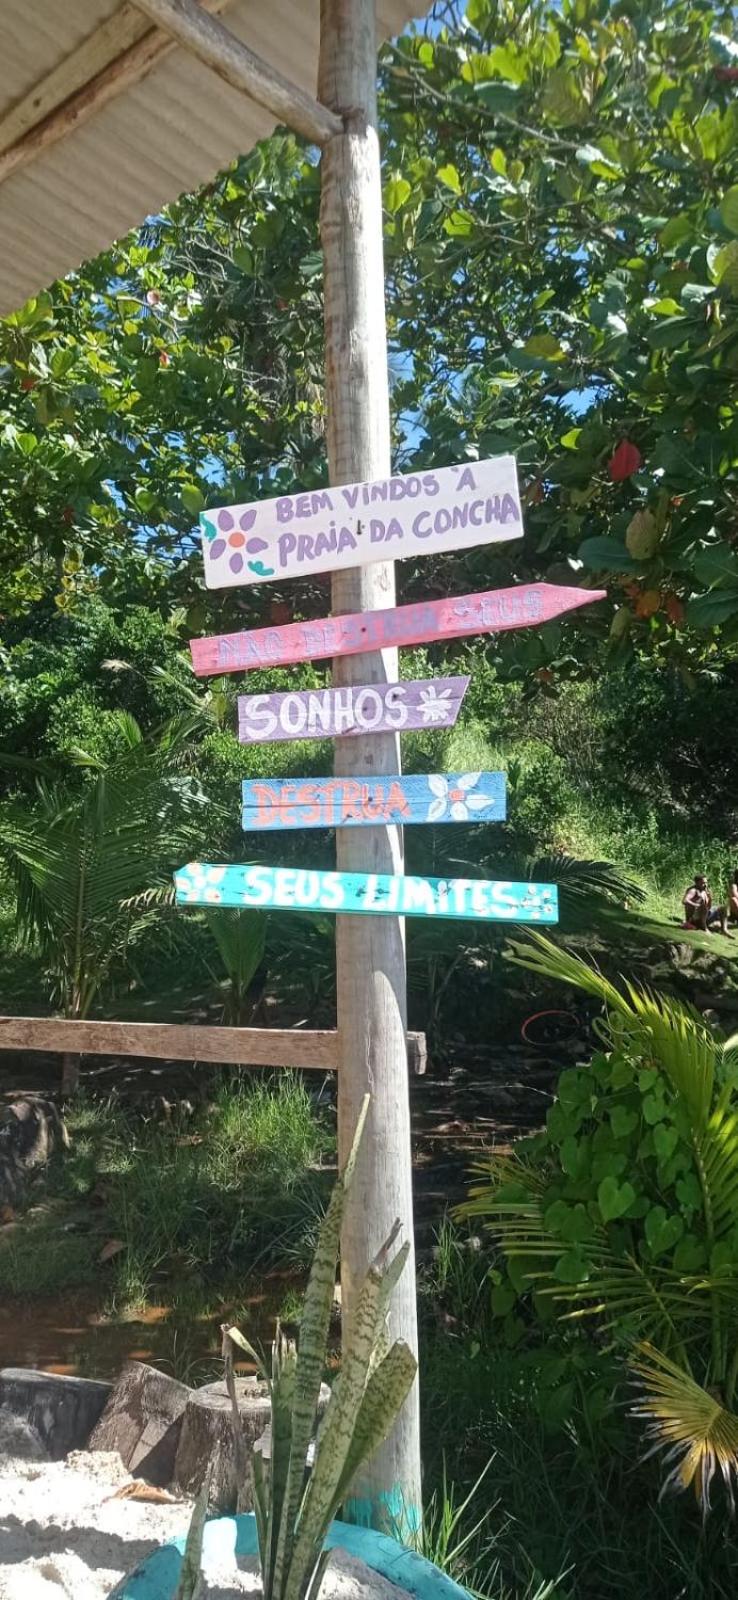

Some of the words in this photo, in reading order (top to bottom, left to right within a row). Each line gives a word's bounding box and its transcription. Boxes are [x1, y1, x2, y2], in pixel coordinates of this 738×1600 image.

[276, 491, 333, 523] BEM
[370, 518, 403, 543] DA
[412, 493, 519, 538] CONCHA
[454, 590, 543, 629] SEUS
[244, 686, 408, 738] SONHOS
[251, 780, 412, 825] DESTRUA
[245, 866, 346, 907] SEUS
[363, 873, 518, 917] LIMITES
